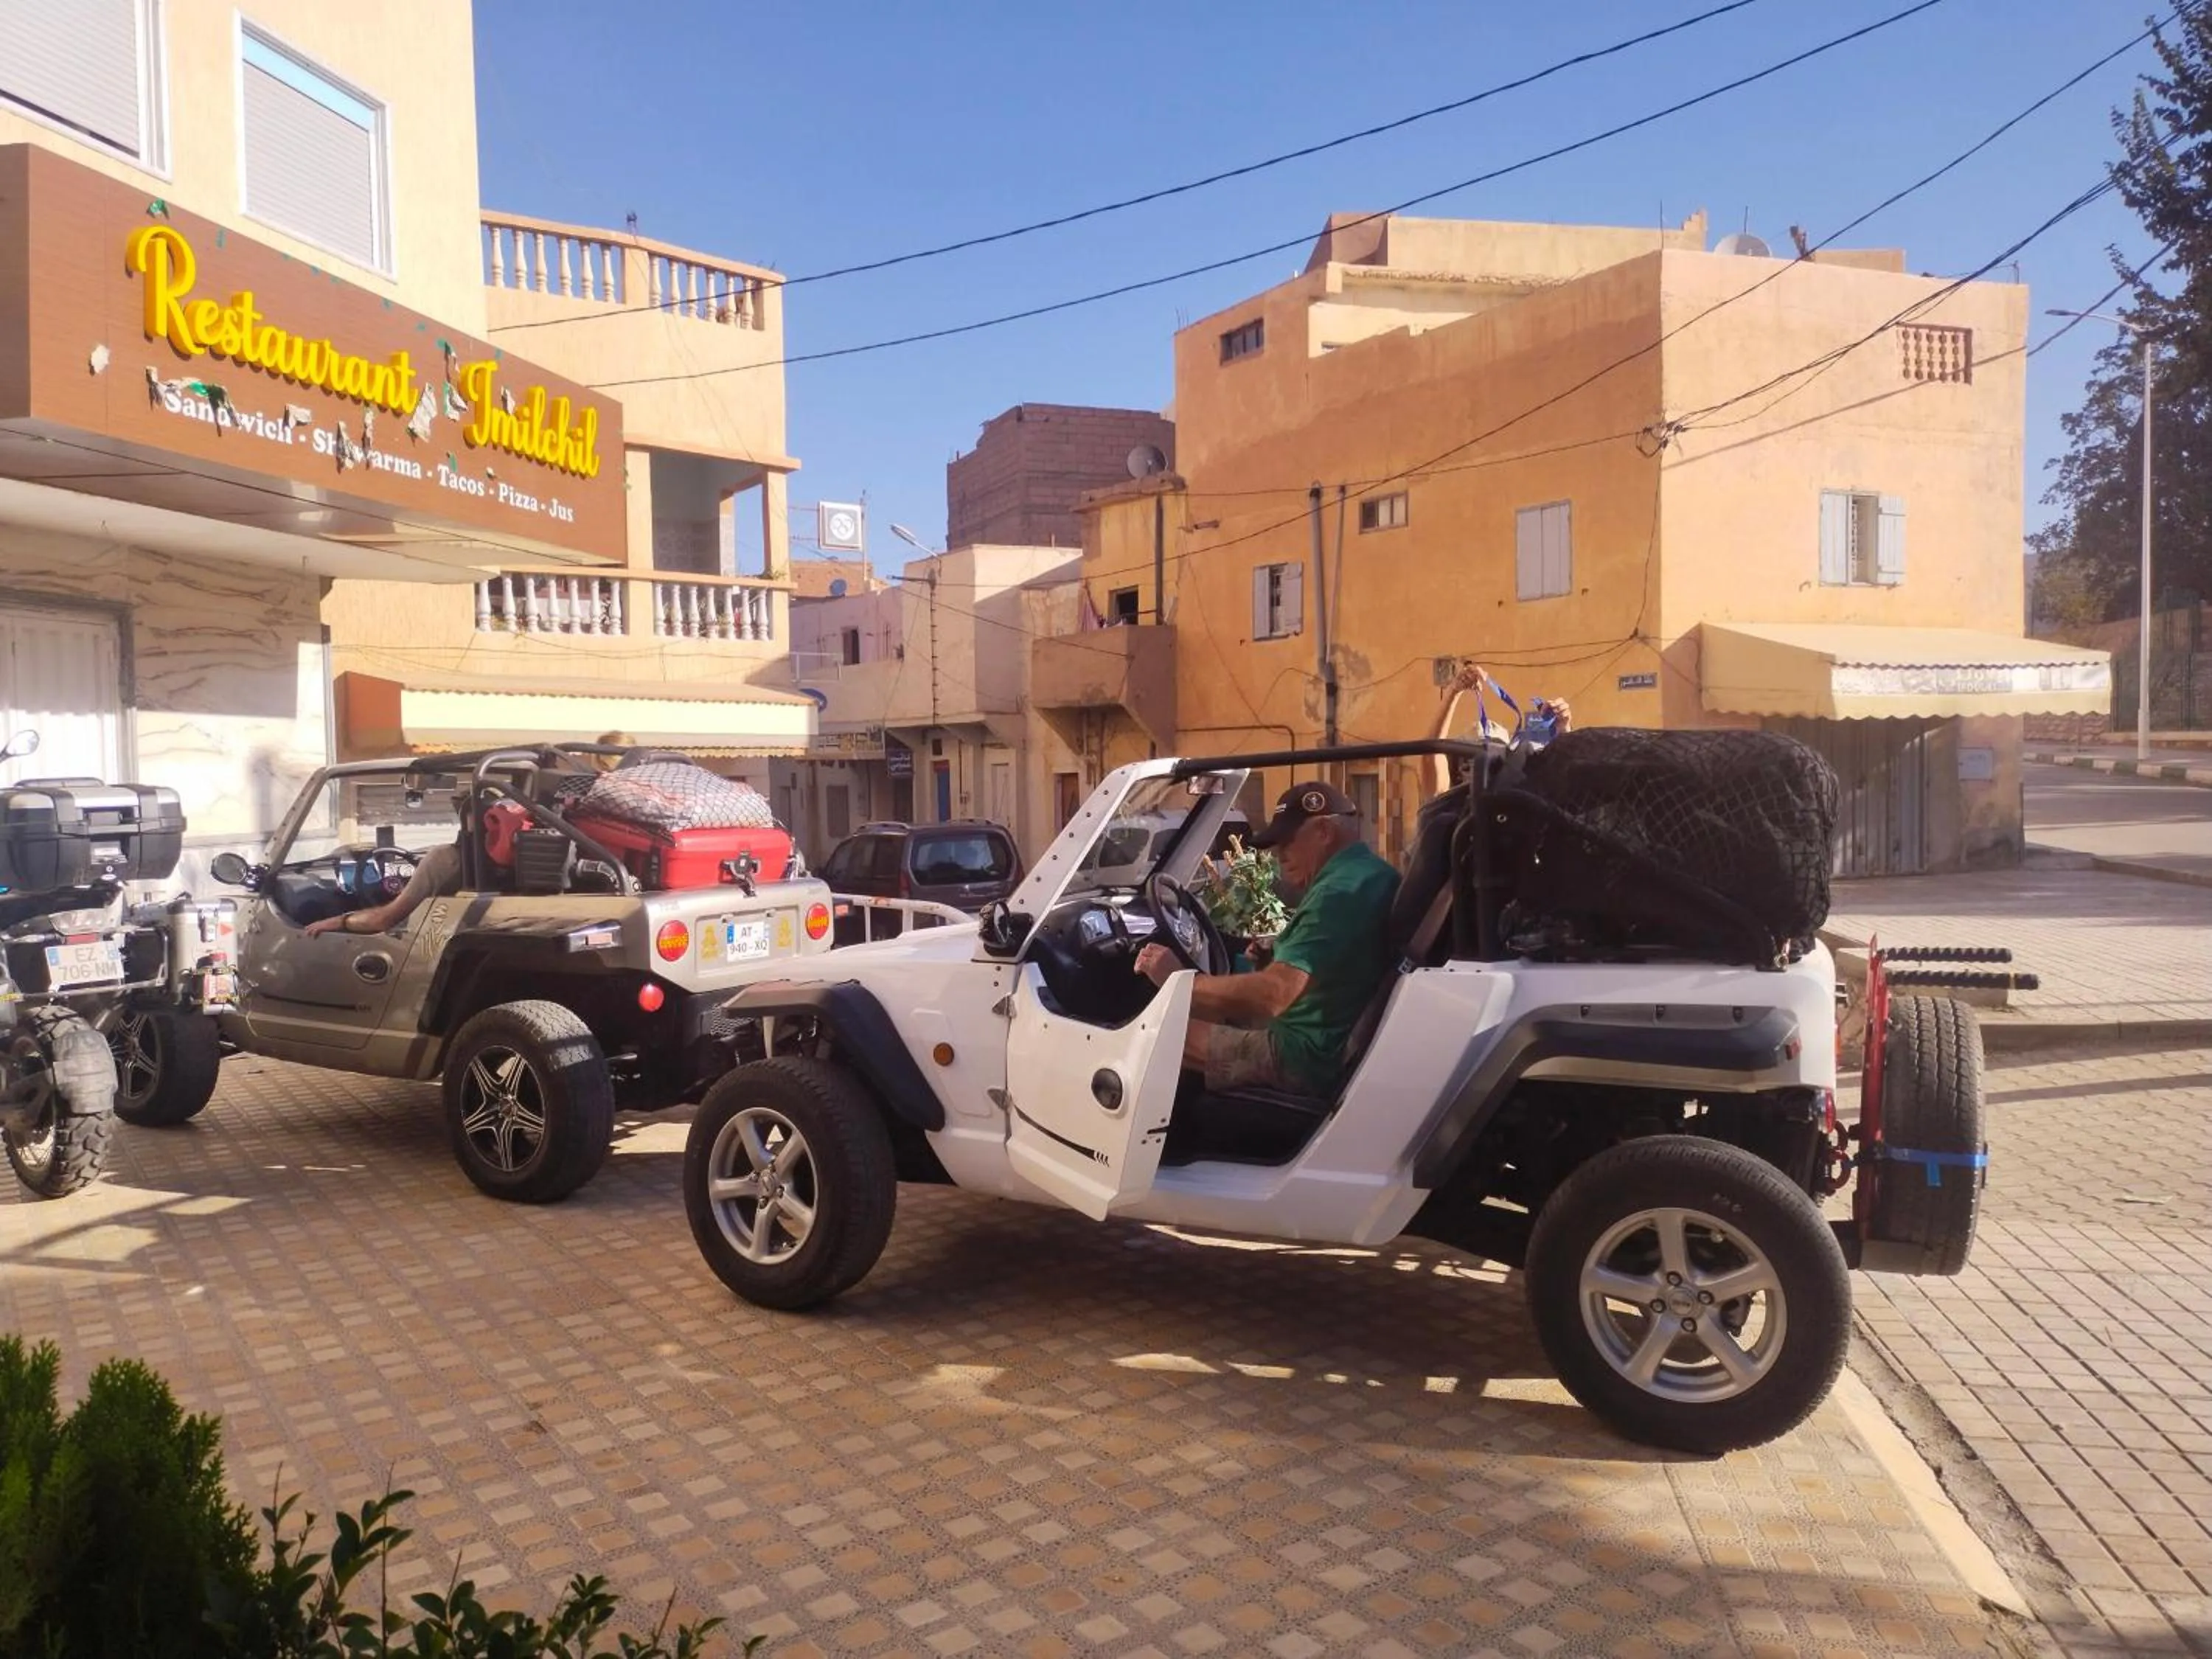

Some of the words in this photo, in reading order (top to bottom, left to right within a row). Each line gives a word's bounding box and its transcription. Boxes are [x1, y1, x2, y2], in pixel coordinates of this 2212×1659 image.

[127, 225, 418, 414] Restaurant
[460, 360, 599, 478] Imilchil
[313, 428, 422, 479] Shwarma
[437, 464, 484, 496] Tacos
[498, 482, 538, 512] Pizza
[549, 498, 574, 522] Jus
